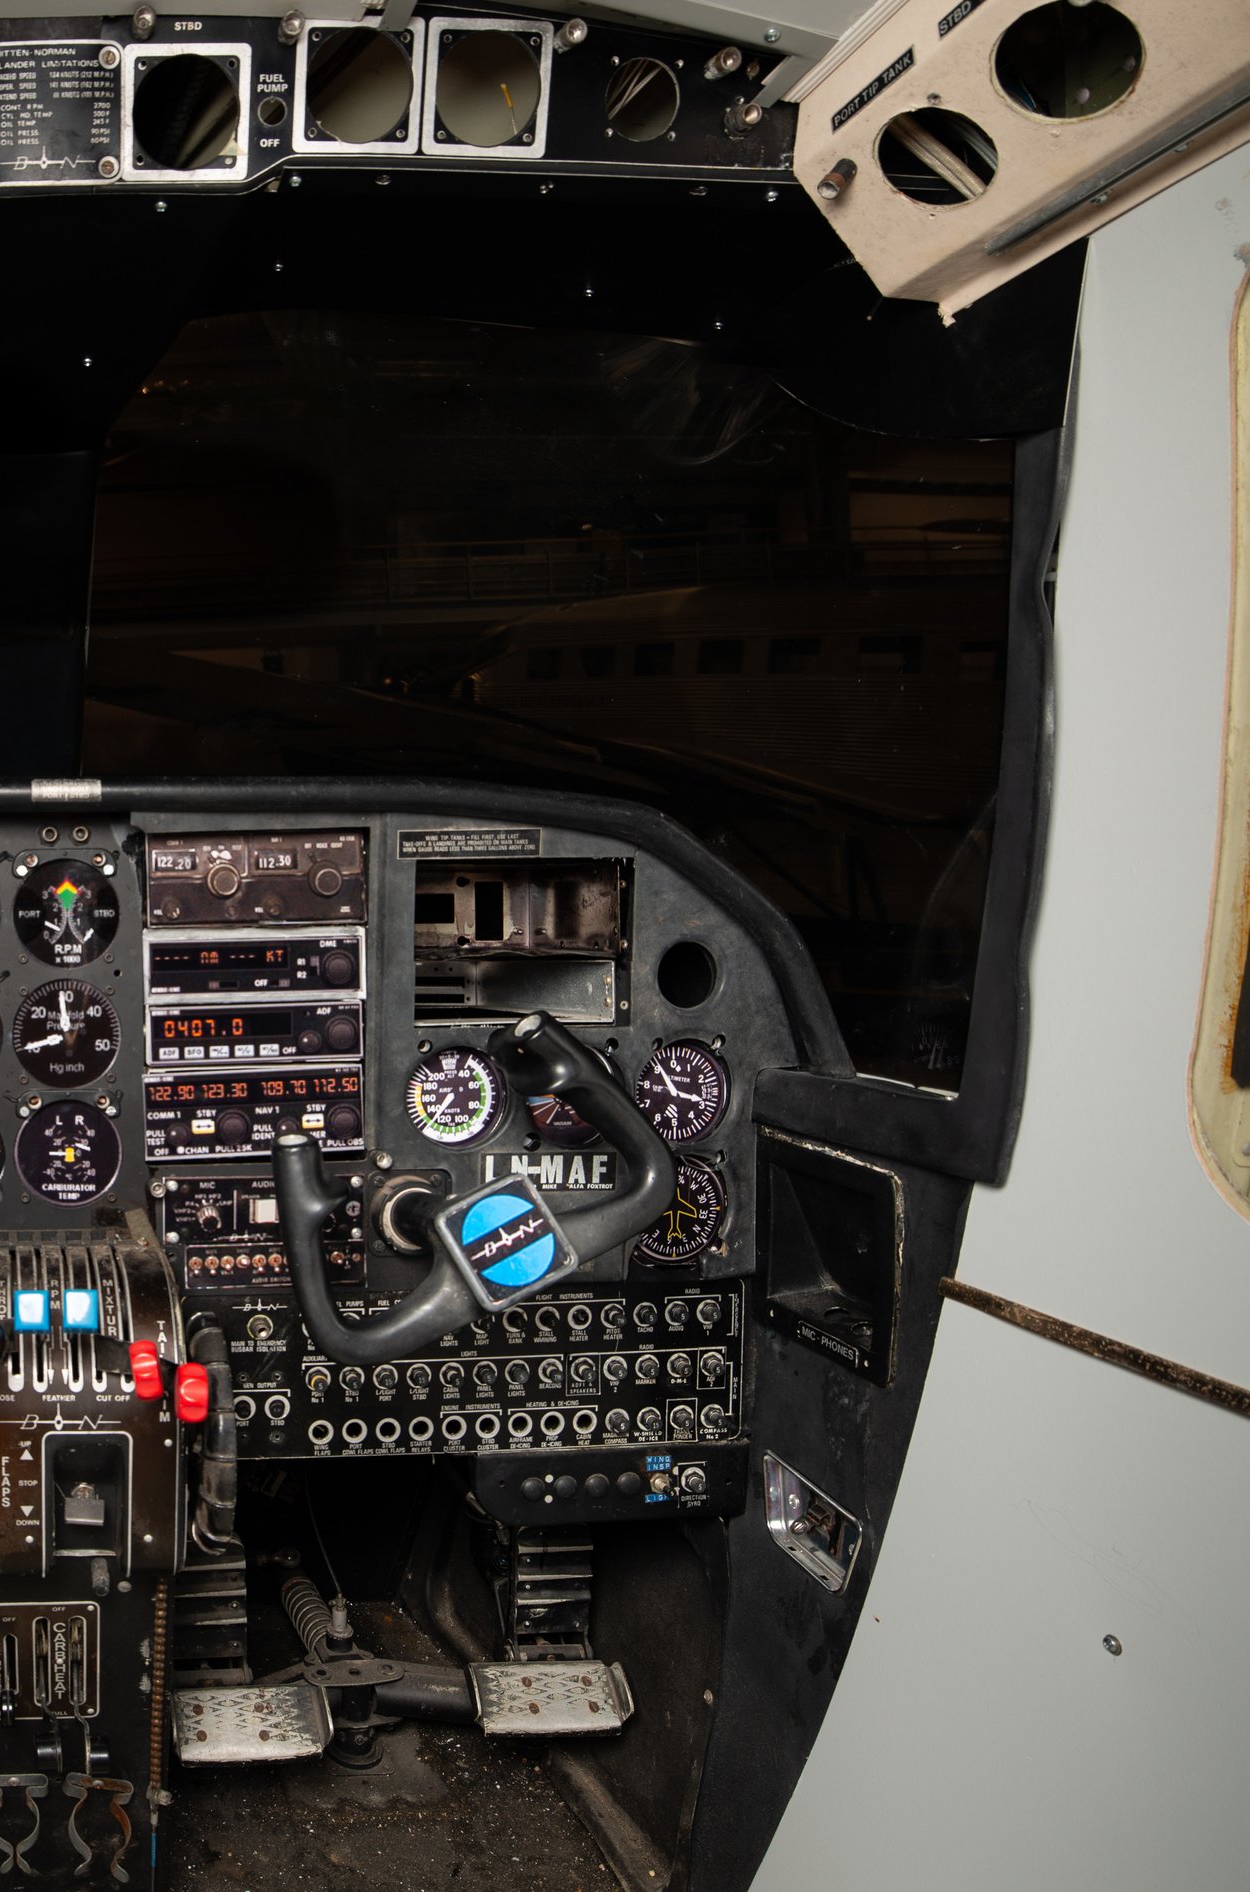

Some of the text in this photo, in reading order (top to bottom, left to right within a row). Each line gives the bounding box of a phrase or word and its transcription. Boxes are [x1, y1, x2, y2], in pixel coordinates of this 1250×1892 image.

[939, 1, 972, 35] STBD
[174, 21, 203, 32] STBD
[41, 59, 99, 68] LIMITATIONS
[259, 73, 285, 84] FUEL
[256, 83, 288, 94] PUMP
[834, 54, 912, 127] PORT TIP TANK
[259, 138, 280, 148] OFF
[157, 855, 192, 870] 122.20
[259, 855, 291, 869] 112.30
[18, 910, 41, 918] PORT
[93, 909, 115, 917] STBD
[254, 979, 268, 987] OFF
[31, 1006, 46, 1019] 20
[86, 1005, 102, 1017] 40
[316, 1007, 332, 1015] ADF
[164, 1018, 243, 1038] 0407.0
[95, 1039, 110, 1051] 50
[50, 1063, 85, 1074] Hg inch
[275, 1106, 279, 1114] 1
[306, 1104, 326, 1112] STBY
[147, 1112, 175, 1120] COMM
[196, 1110, 217, 1118] STBY
[56, 1115, 63, 1125] L
[75, 1115, 84, 1125] R
[253, 1124, 273, 1132] PULL
[146, 1130, 166, 1138] PULL
[147, 1138, 166, 1146] TEST
[326, 1138, 363, 1147] PULL OBS
[154, 1145, 235, 1156] OFF CHAN PULL
[58, 1192, 80, 1200] TEMP
[821, 1336, 854, 1360] PHONES
[1, 1457, 11, 1508] FLAPS
[53, 1623, 66, 1660] CARB
[53, 1664, 67, 1699] HEAT
